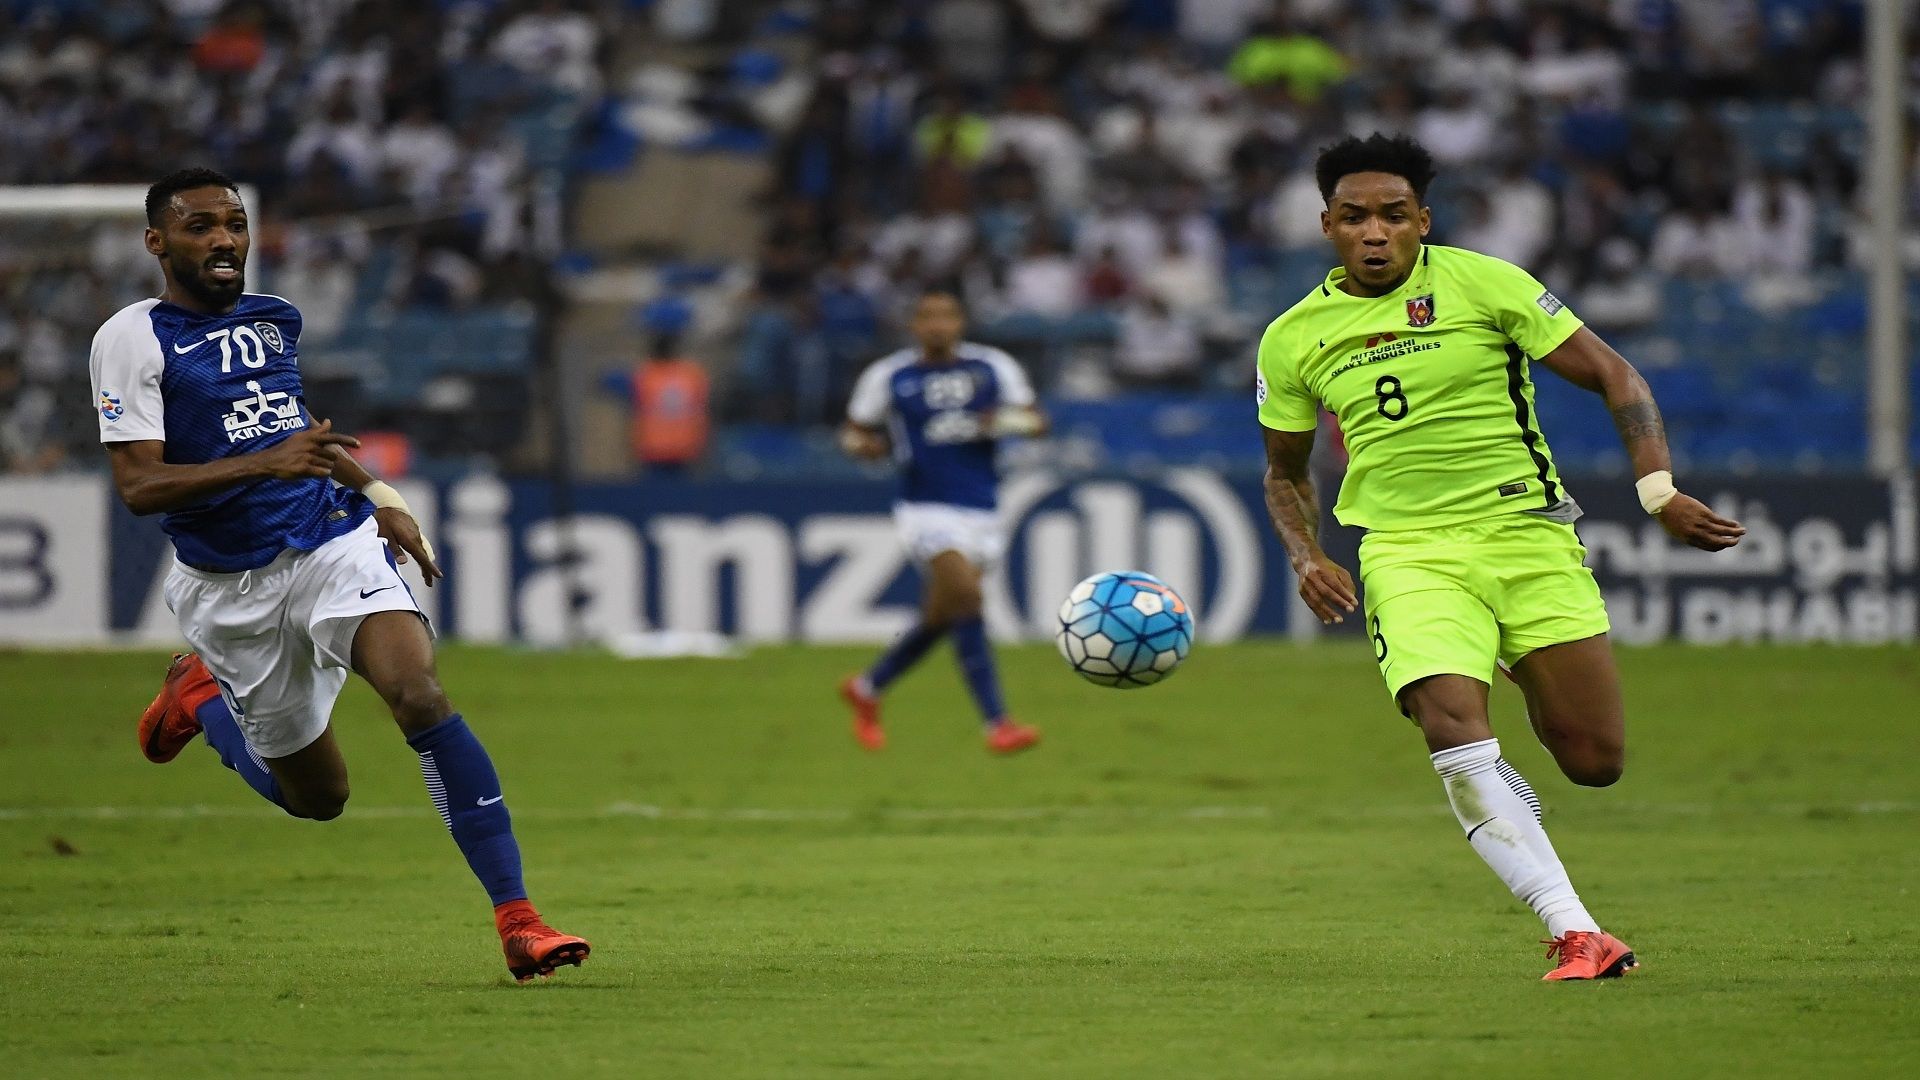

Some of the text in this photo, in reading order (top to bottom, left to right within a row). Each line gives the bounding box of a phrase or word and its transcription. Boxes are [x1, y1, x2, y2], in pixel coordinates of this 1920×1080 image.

[205, 325, 266, 373] 70
[1350, 338, 1416, 362] MITSUBISHI
[1368, 341, 1441, 363] INDUSTRIES
[1375, 375, 1409, 421] 8
